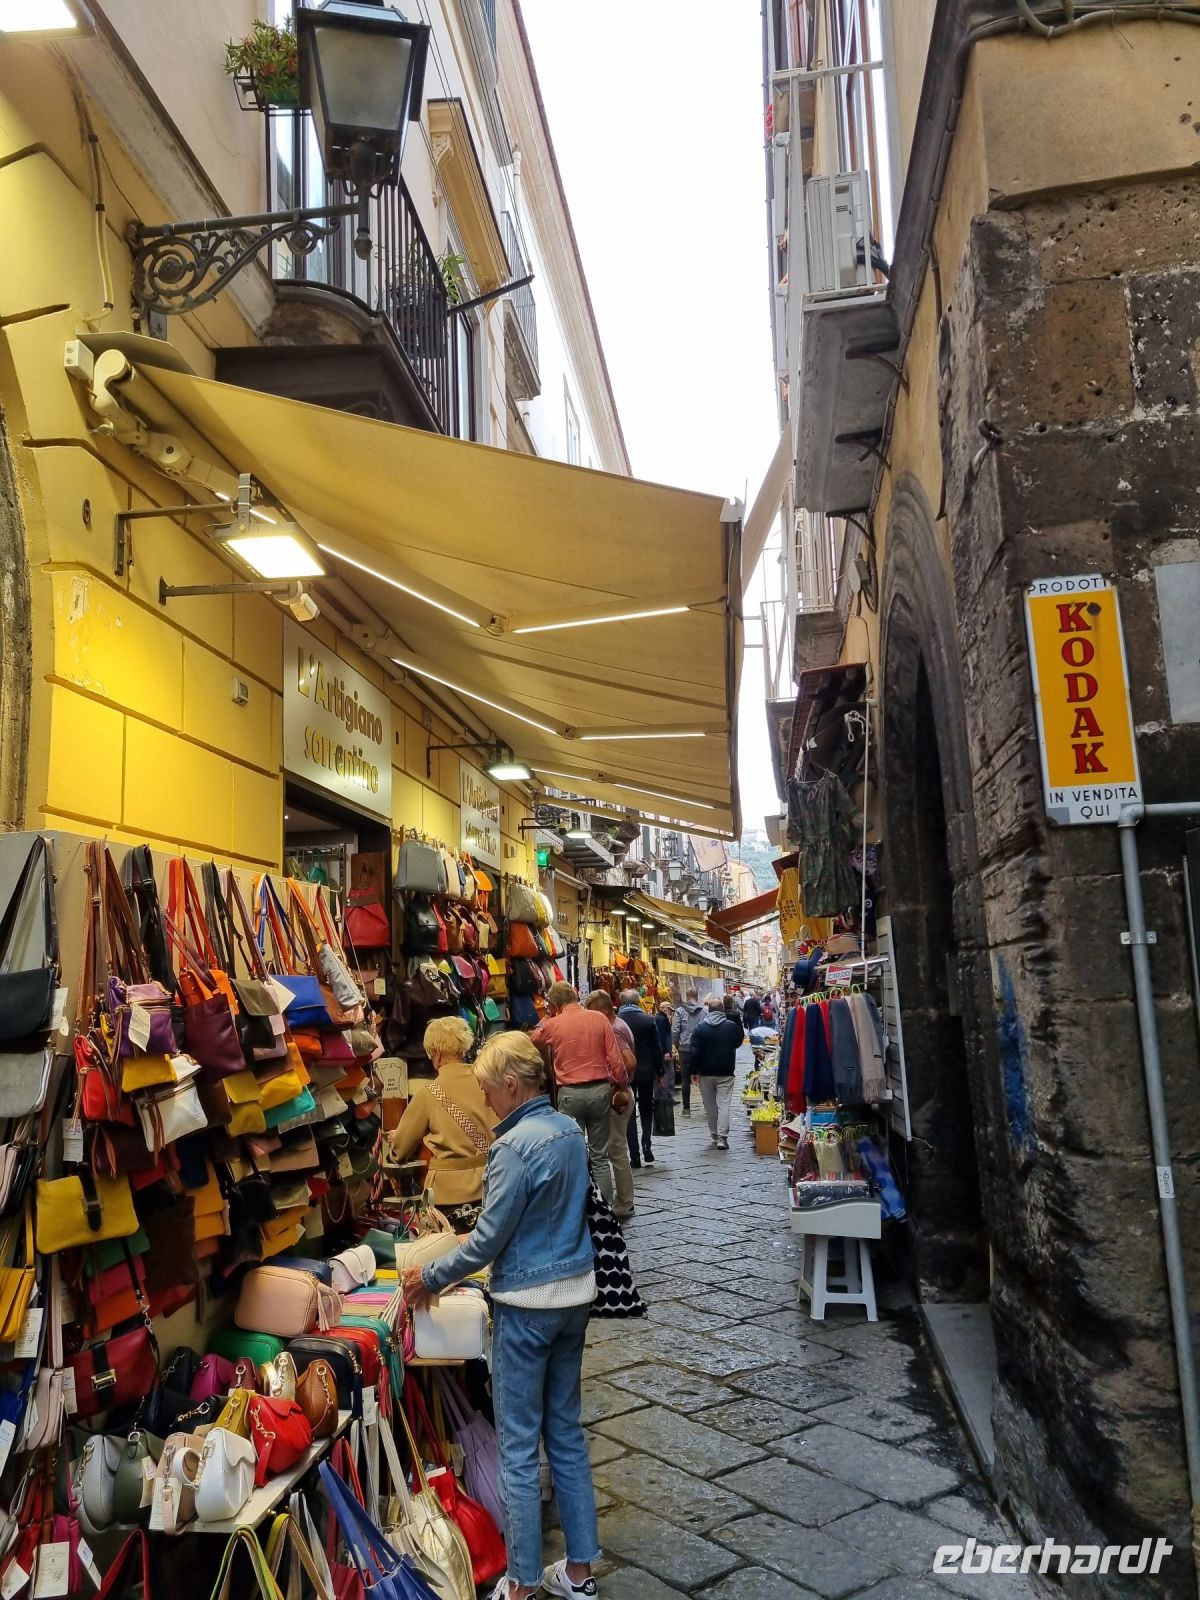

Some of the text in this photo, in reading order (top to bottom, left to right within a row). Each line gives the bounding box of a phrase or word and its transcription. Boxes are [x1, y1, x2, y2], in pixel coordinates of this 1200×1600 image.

[297, 646, 383, 746] L'Artigiano
[1056, 602, 1108, 774] KODAK
[1049, 786, 1138, 804] IN VENDITA
[1080, 804, 1110, 820] QUI
